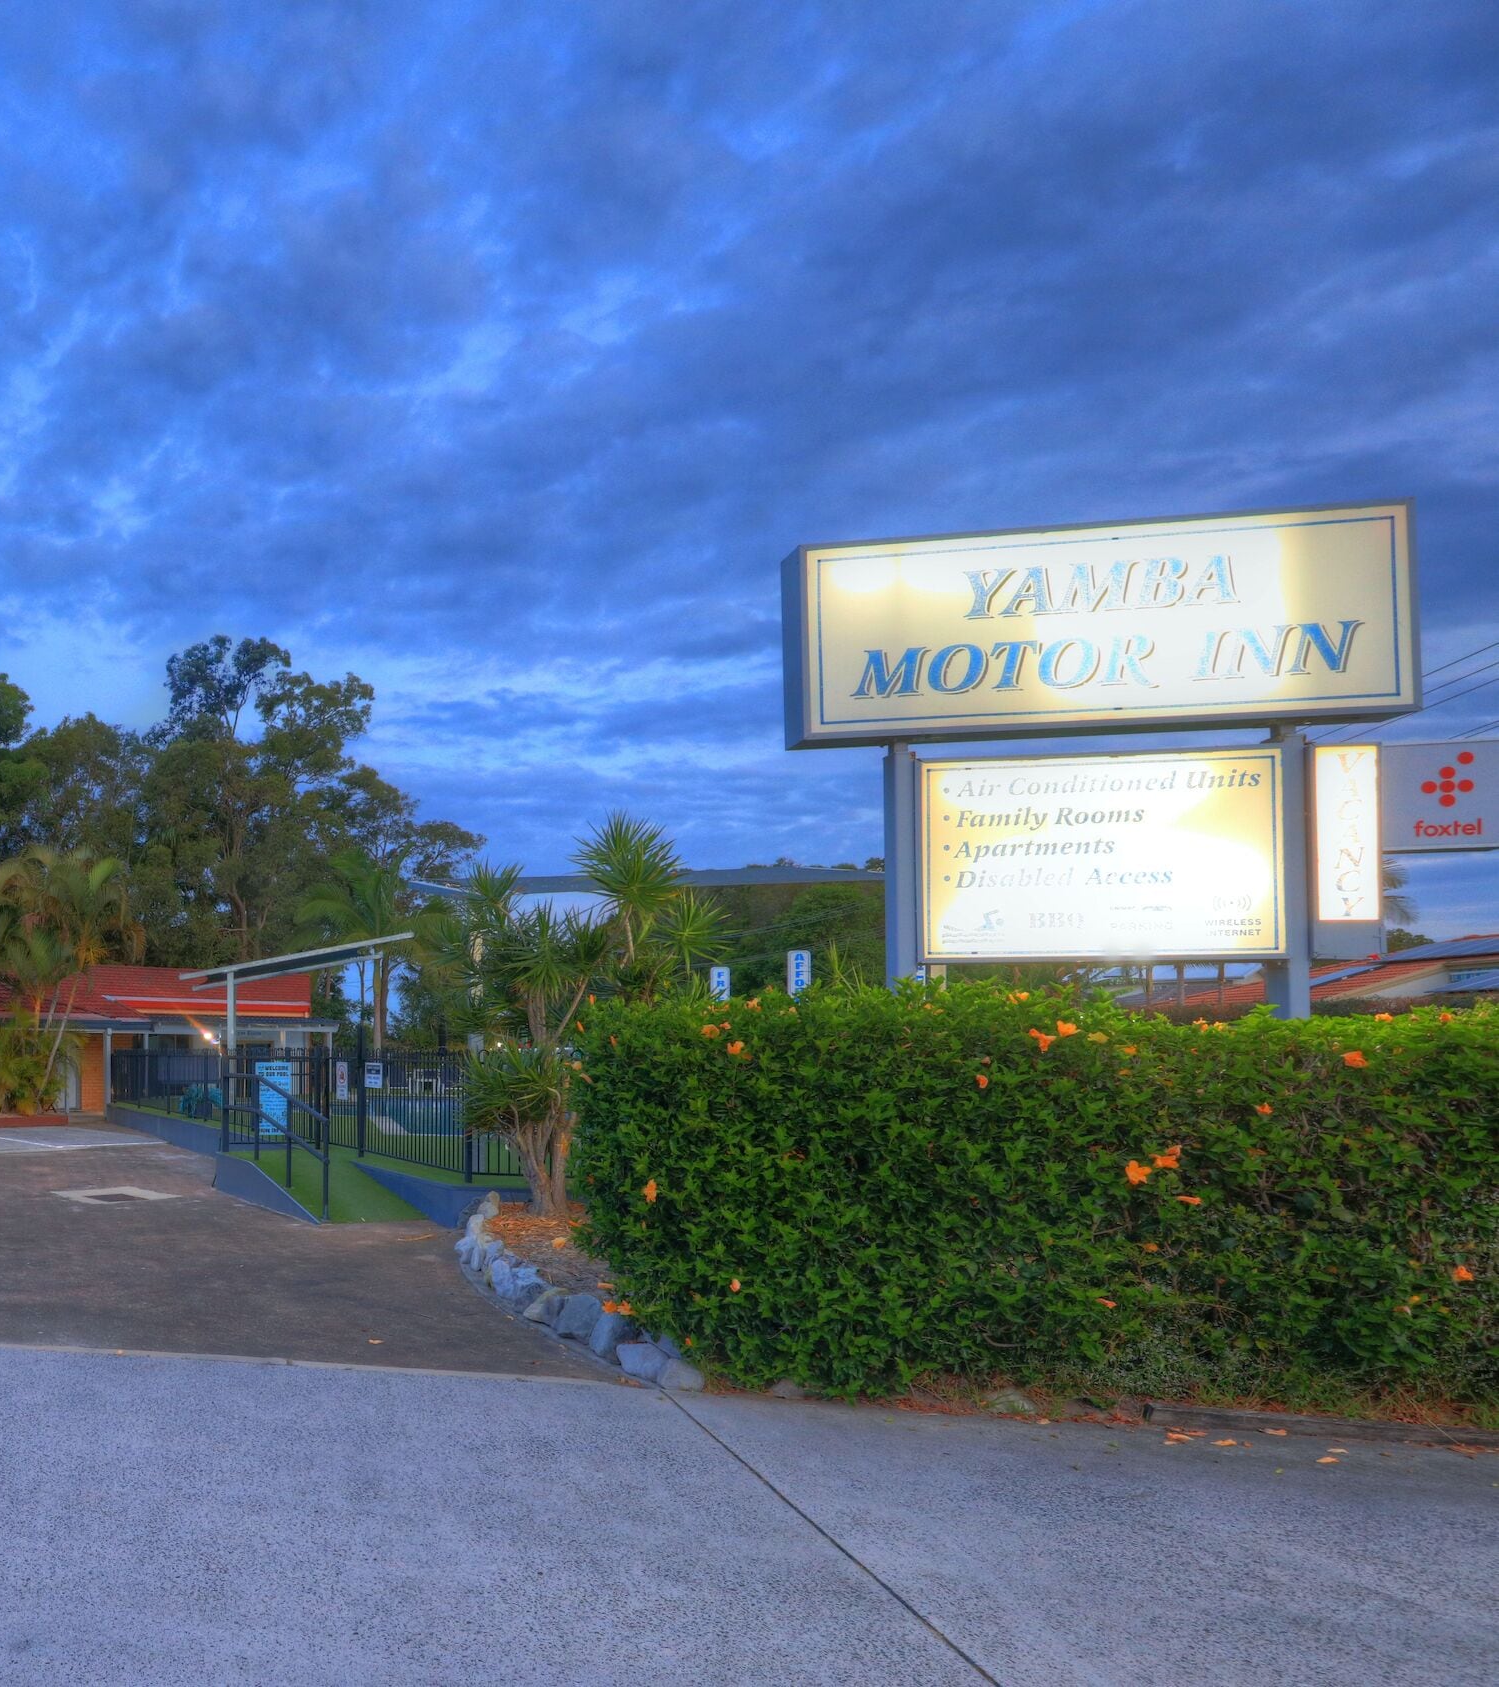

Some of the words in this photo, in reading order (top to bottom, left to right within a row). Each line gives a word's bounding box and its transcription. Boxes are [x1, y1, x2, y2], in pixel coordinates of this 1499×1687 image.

[963, 554, 1240, 619] YAMBA
[850, 633, 1159, 699] MOTOR
[1190, 620, 1365, 682] INN
[957, 779, 1002, 798] Air
[1008, 771, 1177, 797] Conditioned
[1186, 769, 1261, 789] Units
[955, 806, 1048, 831] Family
[1054, 805, 1144, 826] Rooms
[1413, 818, 1482, 837] foxtel
[1334, 752, 1365, 917] VACANCY
[954, 838, 1116, 863] Apartments
[955, 867, 1075, 889] Disabled
[1085, 867, 1173, 886] Access
[1204, 918, 1262, 927] WIRELESS
[1205, 928, 1262, 937] INTERNET
